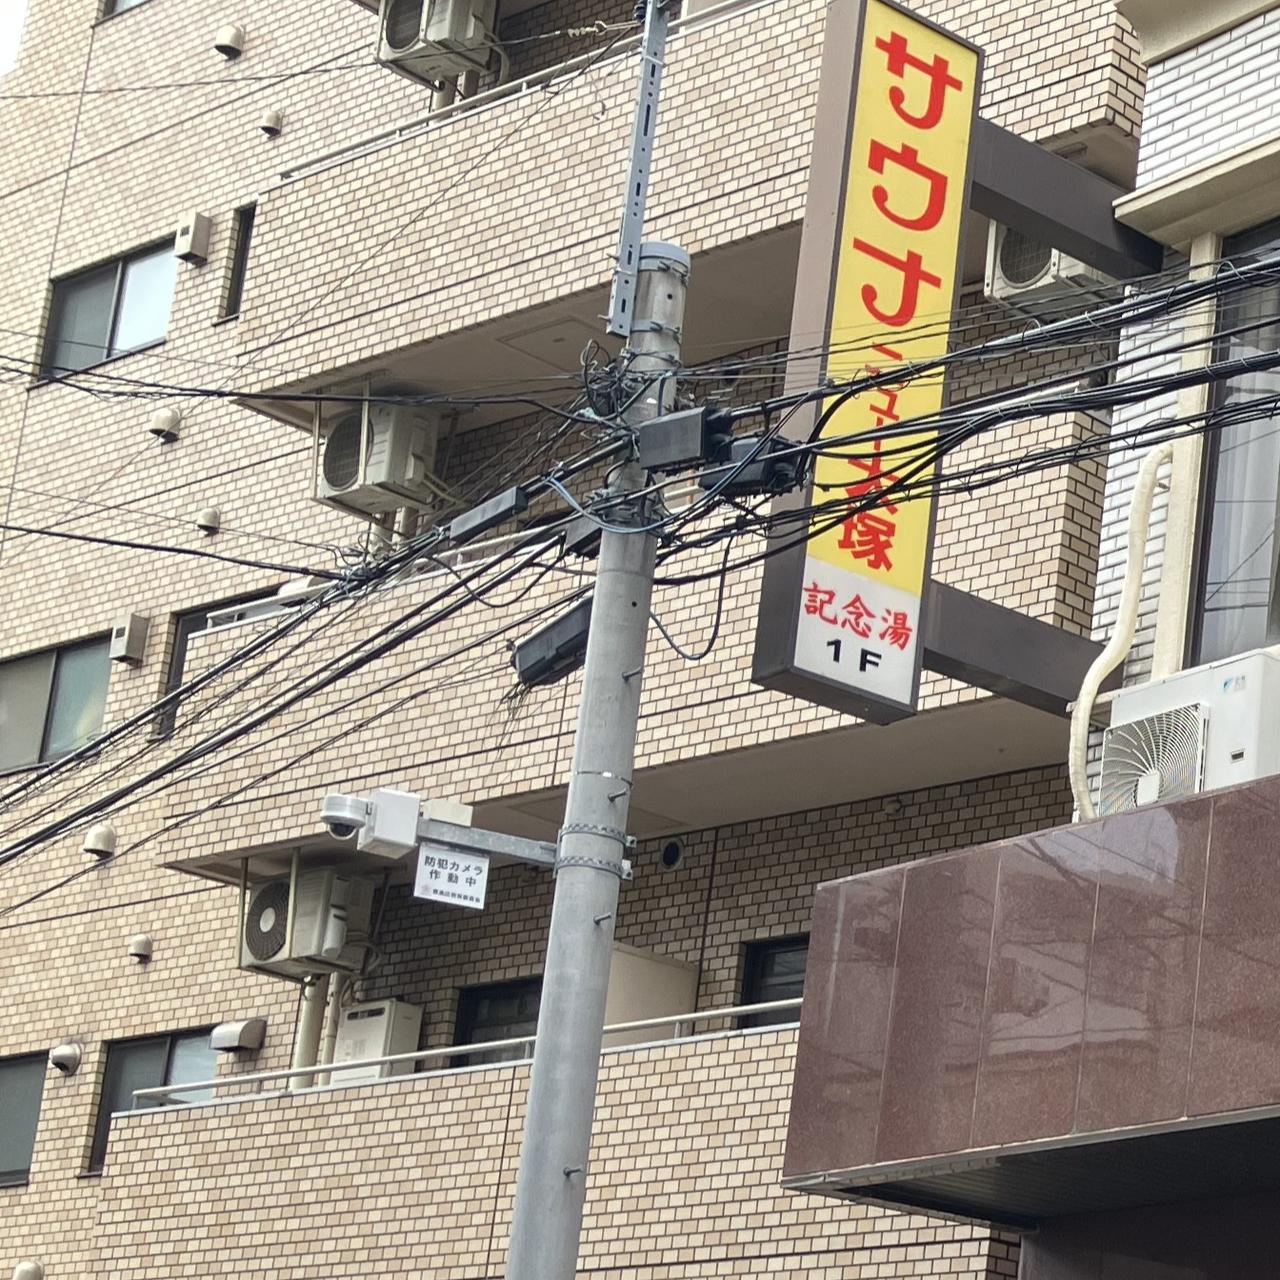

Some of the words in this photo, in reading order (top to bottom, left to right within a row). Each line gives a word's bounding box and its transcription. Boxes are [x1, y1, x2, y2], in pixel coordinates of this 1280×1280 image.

[802, 581, 913, 660] 記念湯
[825, 637, 883, 674] 1F
[424, 855, 483, 876] 防犯カメラ
